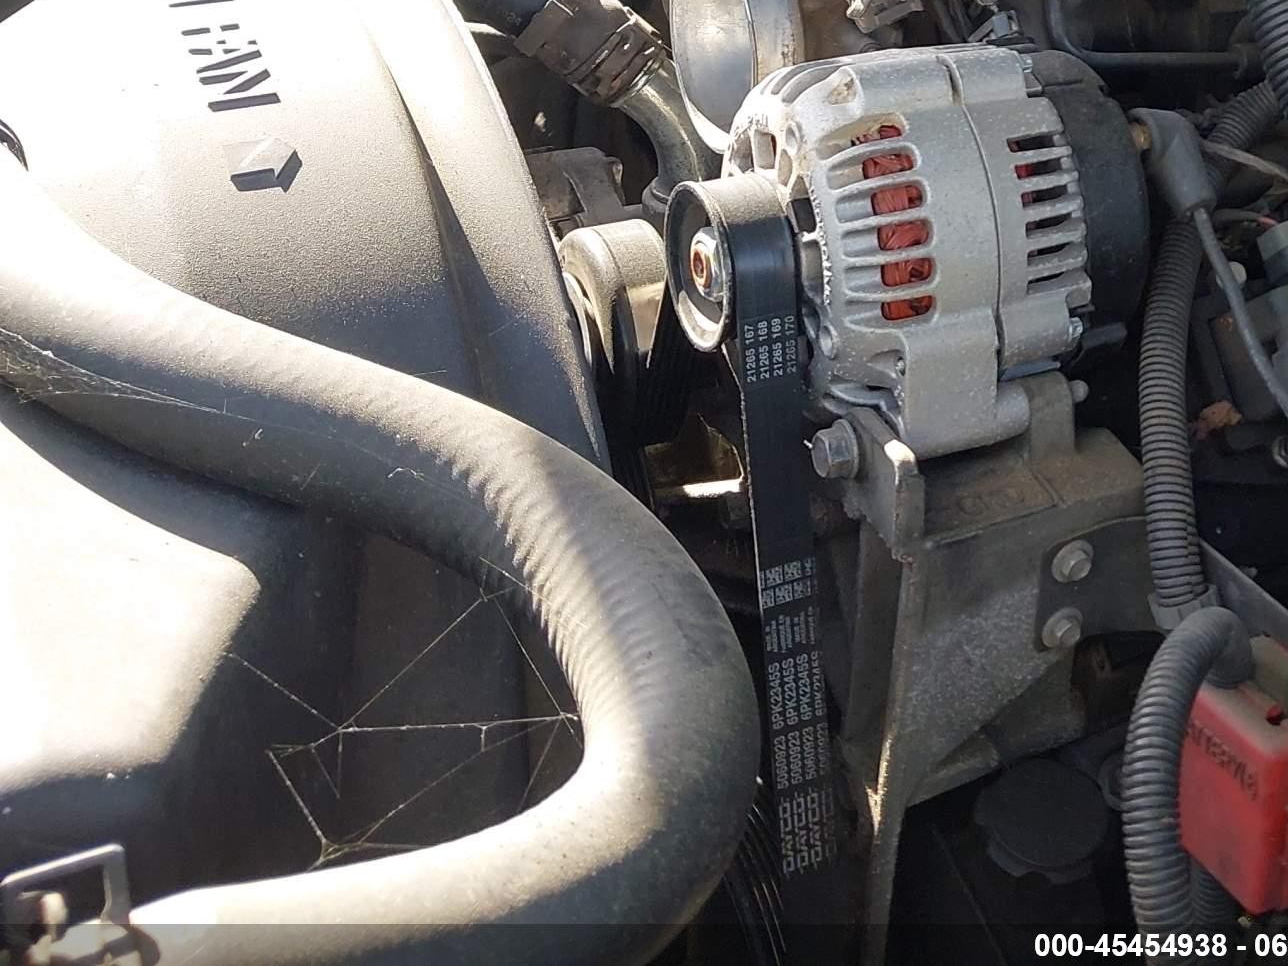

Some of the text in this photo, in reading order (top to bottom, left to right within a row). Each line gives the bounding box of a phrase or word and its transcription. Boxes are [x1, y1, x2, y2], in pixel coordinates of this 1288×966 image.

[180, 22, 283, 113] FAN
[745, 325, 757, 382] 21265 167
[758, 321, 770, 379] 21265 168
[771, 318, 783, 377] 21265 169
[785, 316, 797, 373] 21265 170
[768, 662, 783, 730] 6PK2345S
[782, 657, 797, 725] 6PK2345S
[797, 653, 811, 720] 6PK2345S
[774, 735, 789, 789] 5060923
[789, 731, 804, 784] 5060923
[803, 726, 817, 779] 5060923
